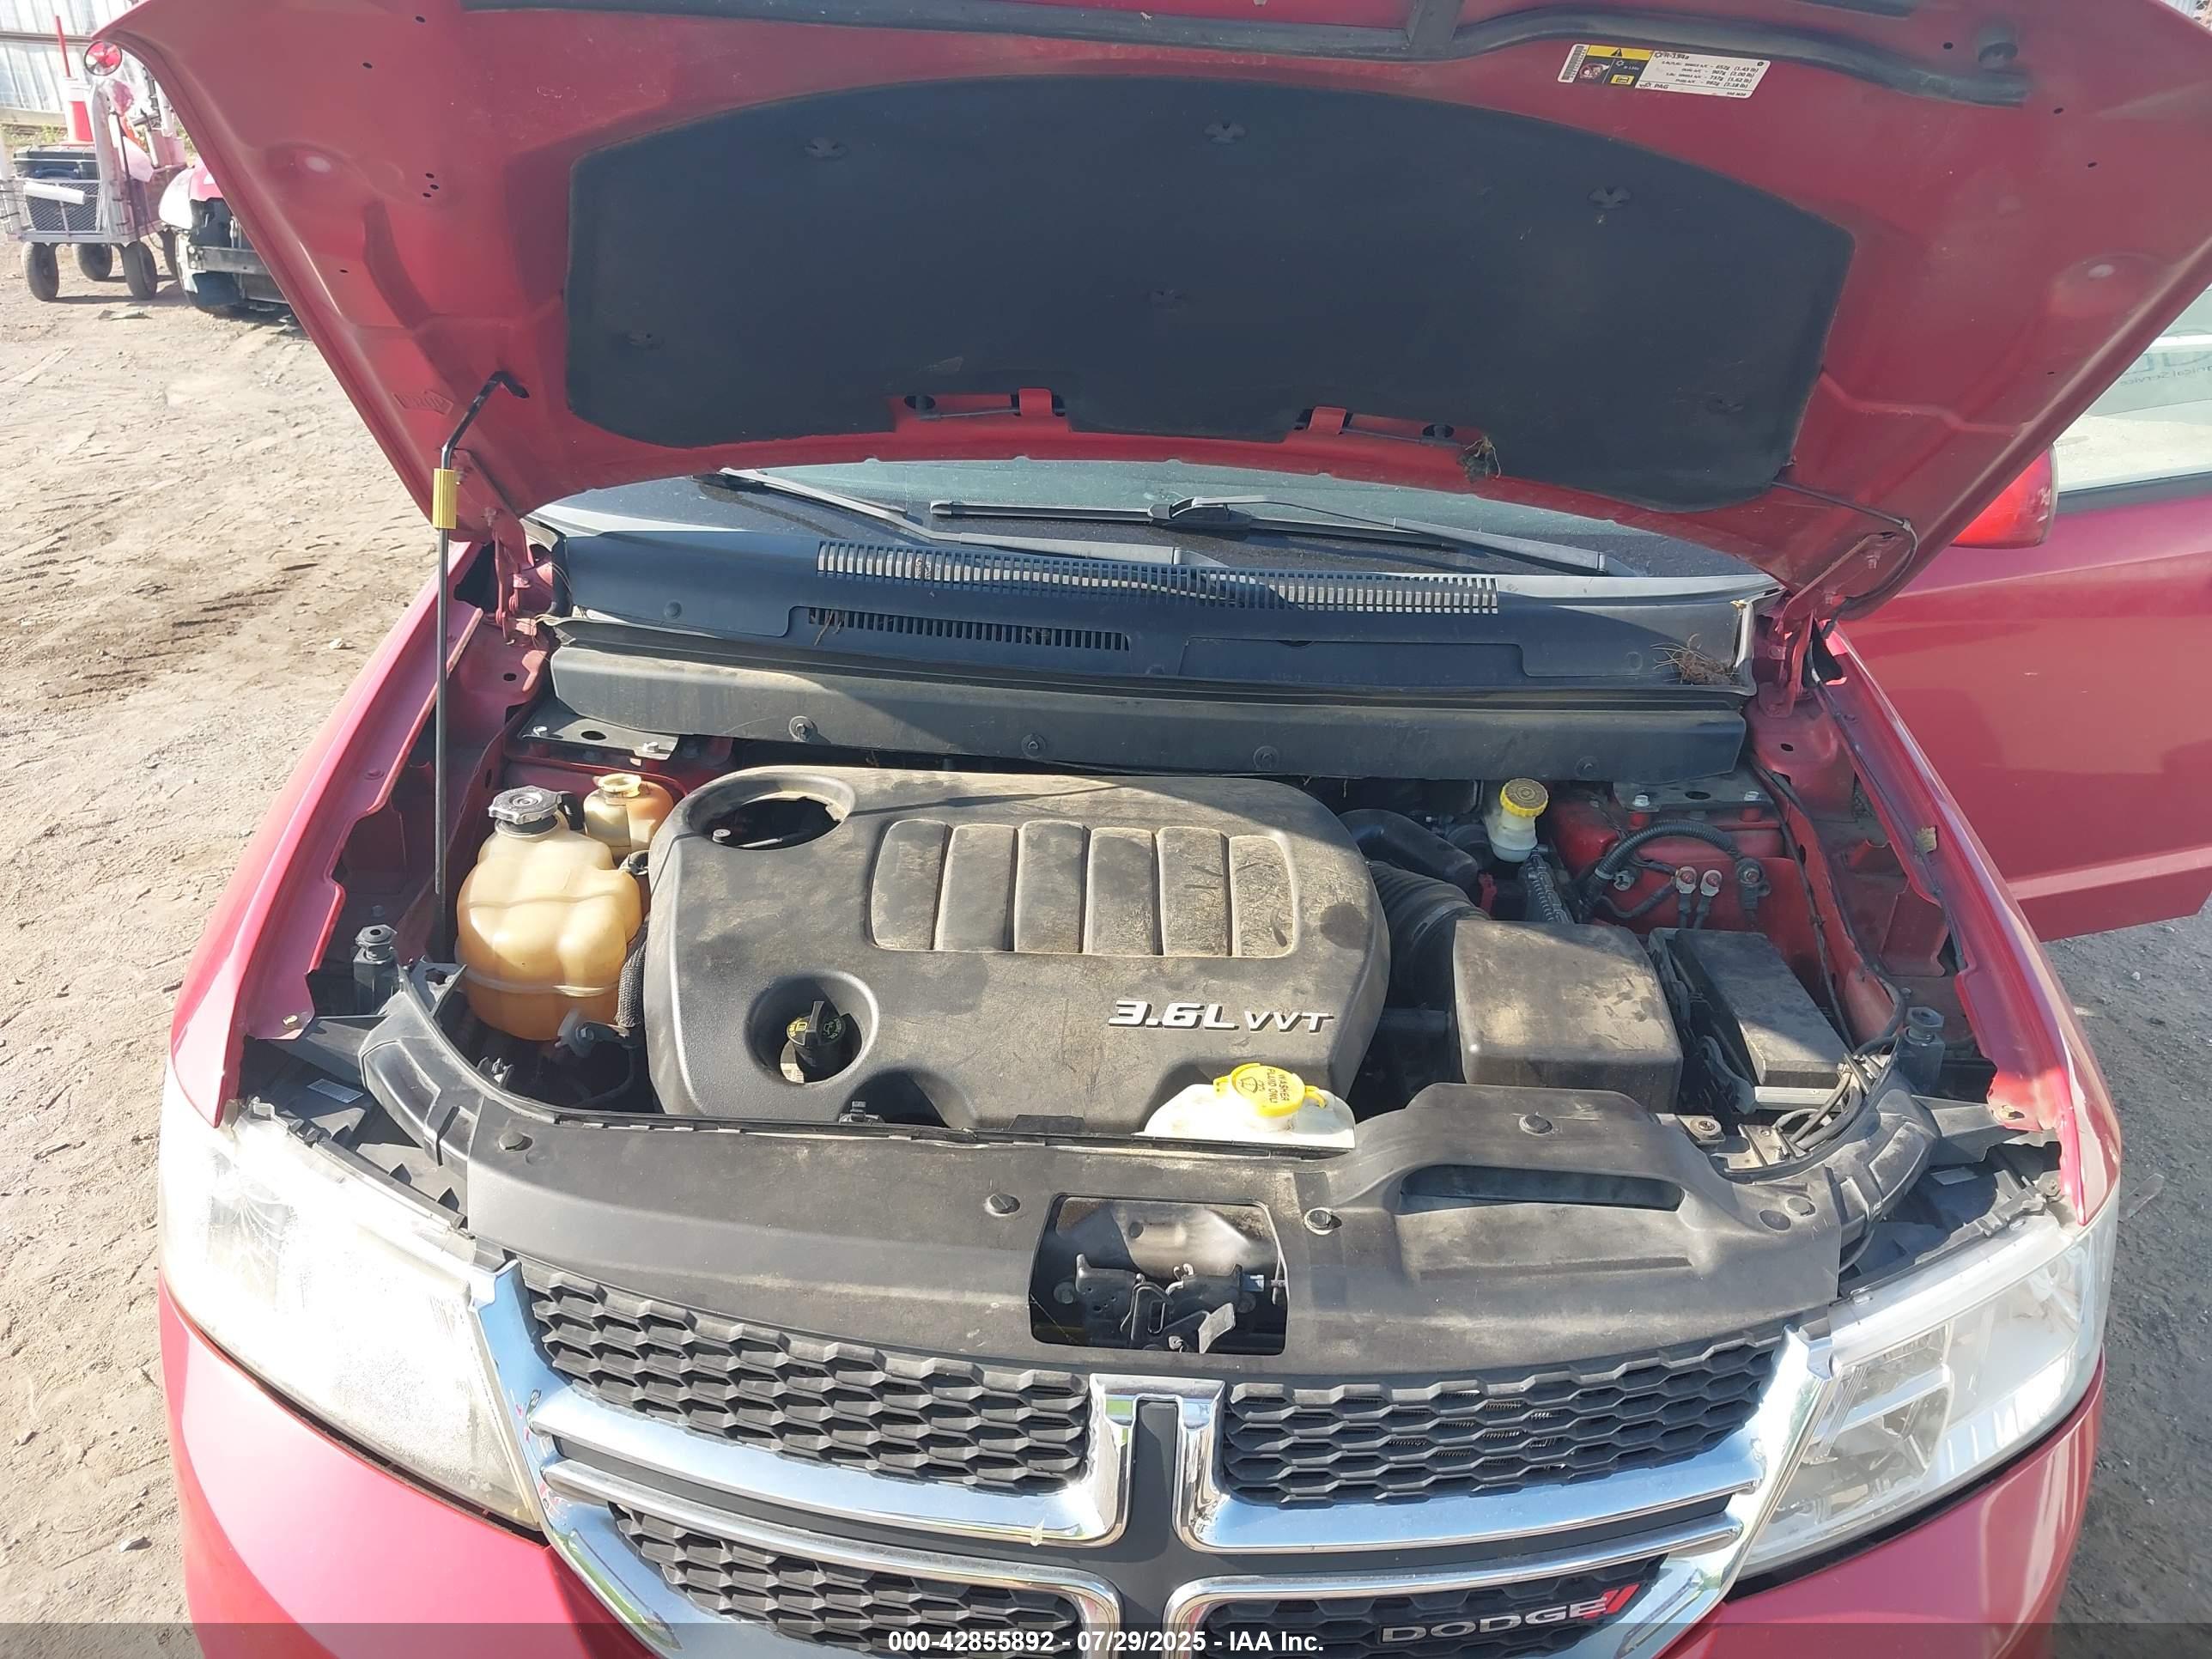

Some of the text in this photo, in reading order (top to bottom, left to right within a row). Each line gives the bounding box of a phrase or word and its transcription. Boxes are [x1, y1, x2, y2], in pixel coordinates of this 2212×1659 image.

[1664, 52, 1690, 60] R-134a
[1108, 1000, 1334, 1033] 3.6L VVT
[1267, 1067, 1277, 1087] FLUID
[1279, 1073, 1290, 1102] WASHER
[1382, 1596, 1607, 1643] DODGE
